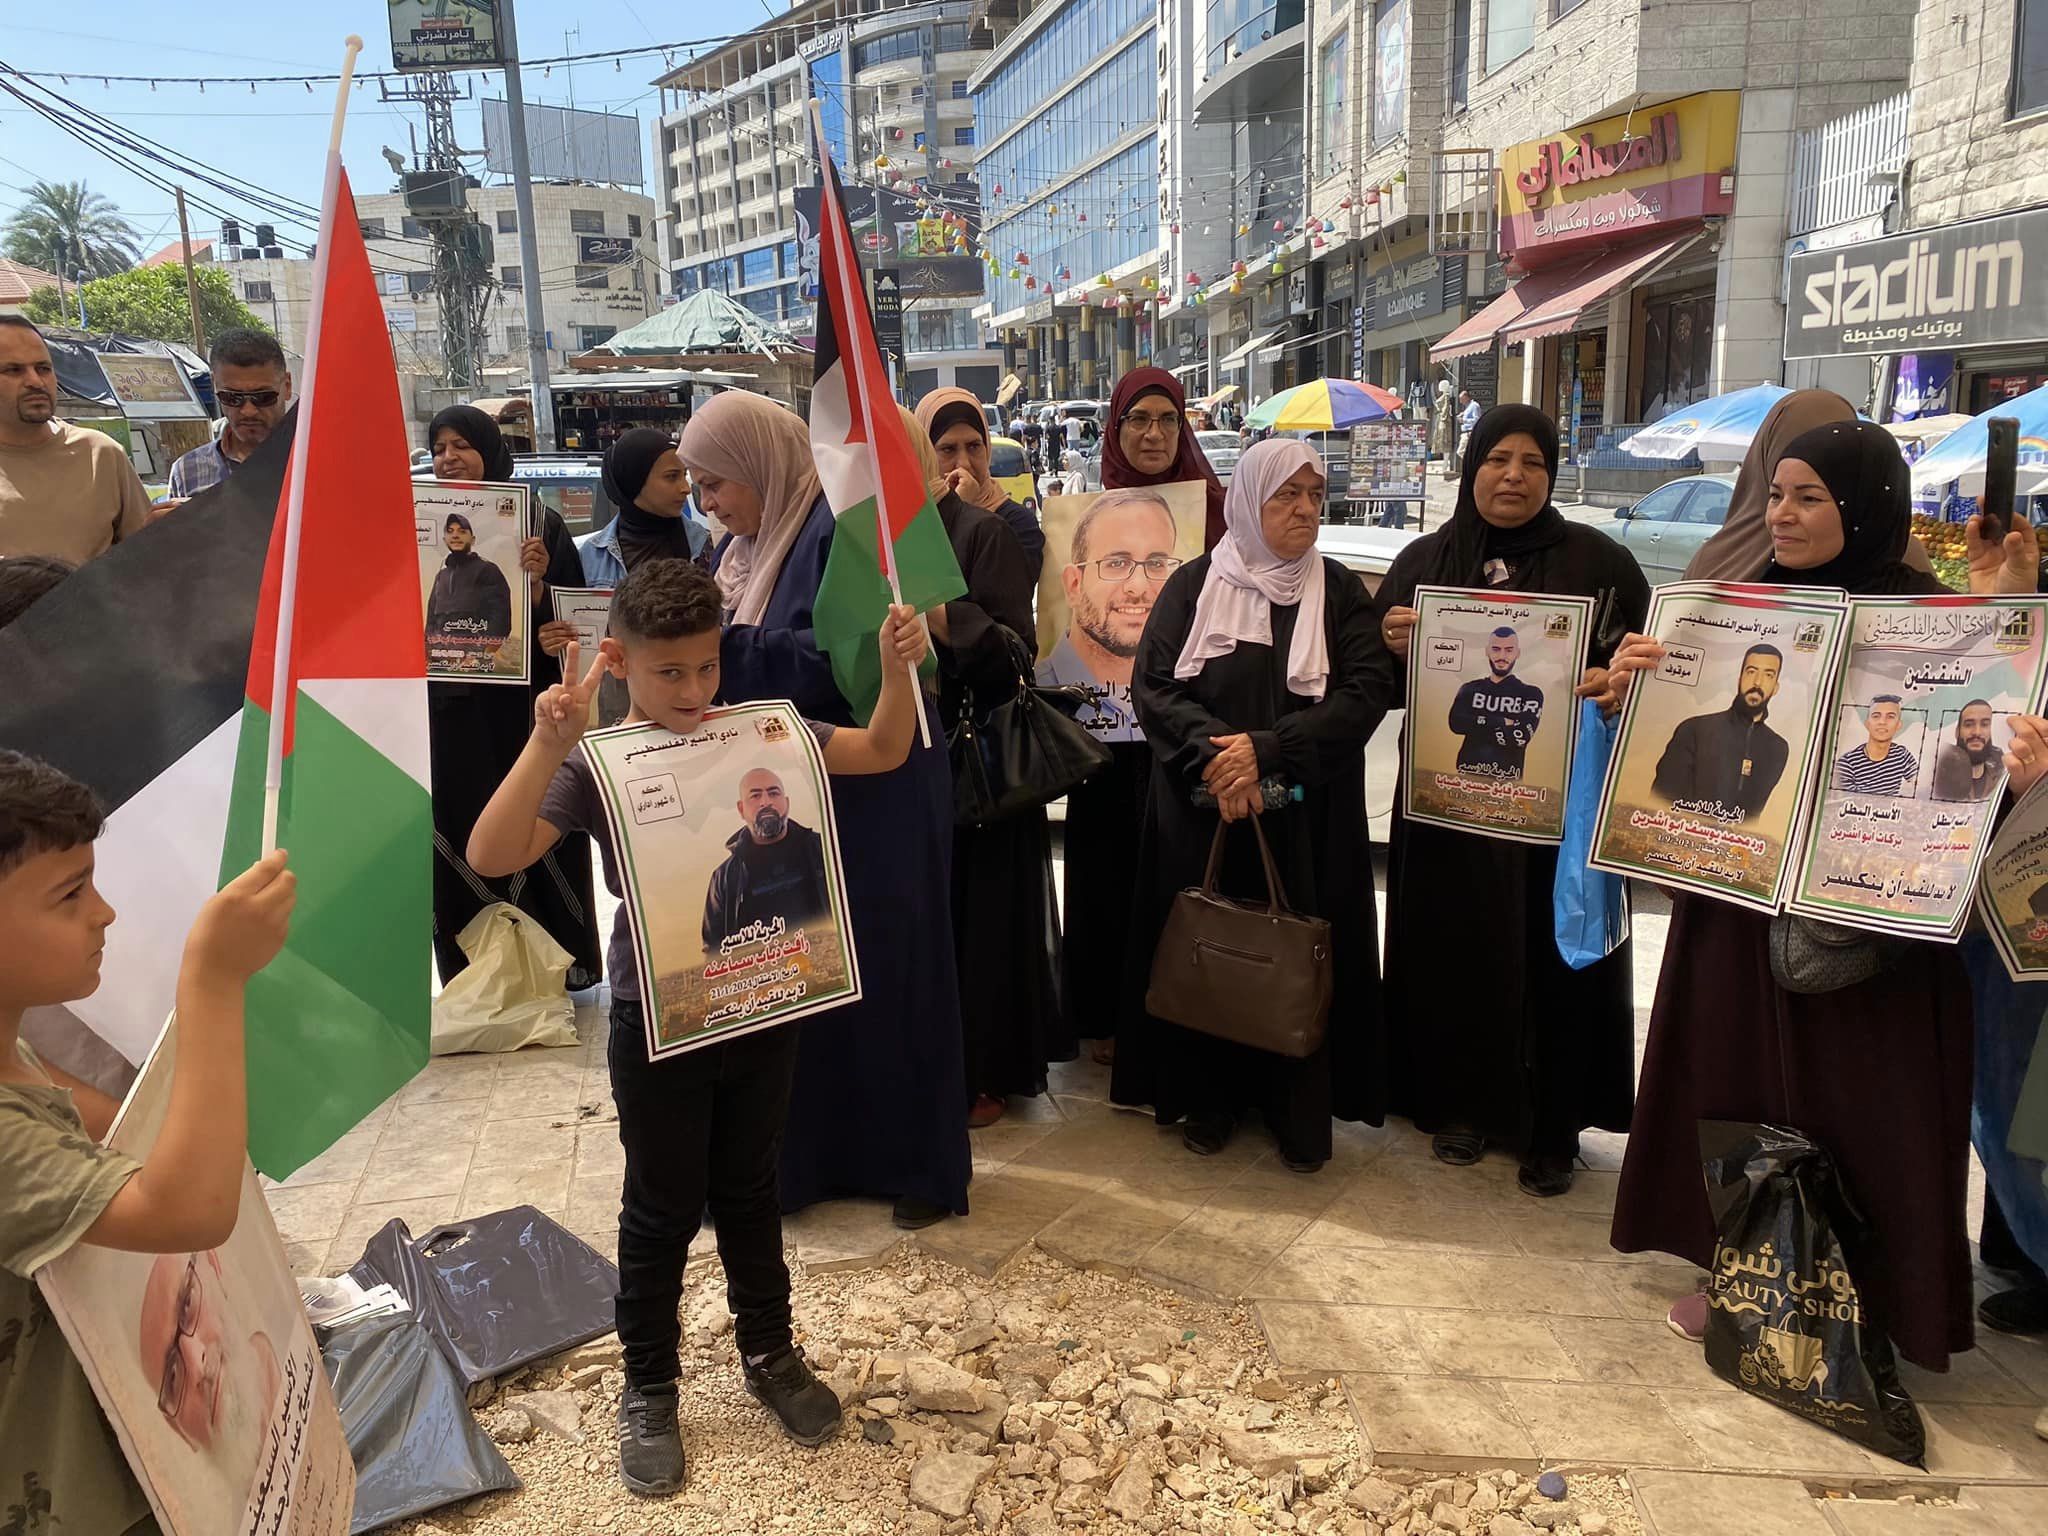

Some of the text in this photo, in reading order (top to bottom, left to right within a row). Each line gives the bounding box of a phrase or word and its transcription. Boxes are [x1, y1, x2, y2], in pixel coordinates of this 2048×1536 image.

[1516, 112, 1682, 207] المسلماني
[1619, 192, 1663, 223] شوكولا
[1801, 238, 2024, 330] stadium
[1842, 319, 1963, 345] بوتيك ومخيطة
[514, 467, 568, 478] POLICE
[1436, 602, 1530, 623] نادي الأسير الفلسطيني
[1675, 612, 1779, 641] نادي الأسير الفلسطيني
[1434, 642, 1460, 652] الحكم
[1667, 650, 1699, 662] الحكم
[1665, 665, 1692, 677] موقوف
[624, 727, 739, 765] نادي الأسير الفلسطيني
[641, 784, 665, 796] الحكم
[1462, 779, 1491, 793] حسين
[653, 797, 670, 809] شهور
[669, 795, 676, 804] 6
[1712, 801, 1746, 823] الحرية
[1839, 802, 1902, 824] الأسير البطل
[1685, 820, 1723, 844] يوسف
[1722, 831, 1753, 850] محمد
[1875, 831, 1903, 848] بركات
[1750, 838, 1766, 856] ورد
[1735, 870, 1744, 882] لا
[1821, 872, 1886, 898] ينكسر
[1886, 871, 1905, 898] أن
[1946, 883, 1957, 901] لا
[764, 916, 796, 945] الحرية
[791, 928, 821, 957] رأفت
[752, 971, 781, 989] الاعتقال
[780, 965, 799, 981] تاريخ
[704, 982, 807, 1028] لا بد للقيد أن ينكسر
[1711, 1235, 1782, 1278] شوز
[1713, 1274, 1789, 1308] EAUTY
[297, 1344, 315, 1426] الشيخ
[290, 1420, 303, 1465] عبد
